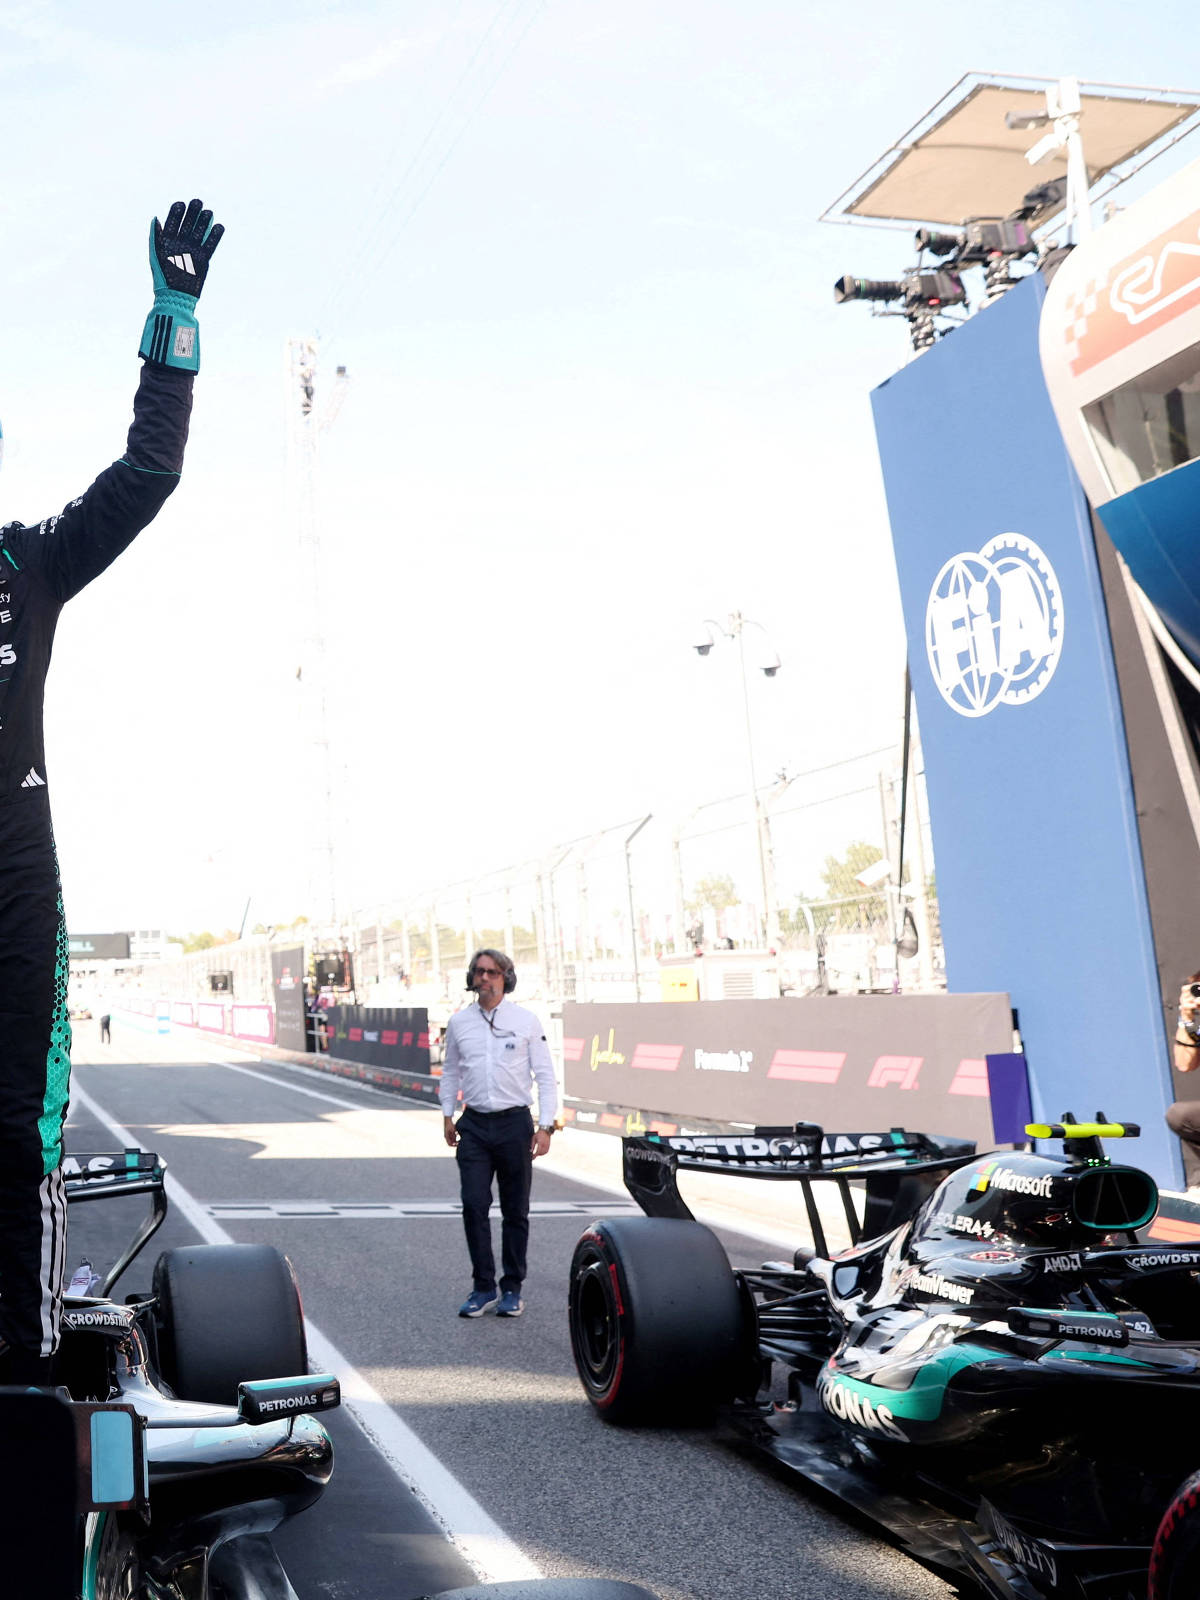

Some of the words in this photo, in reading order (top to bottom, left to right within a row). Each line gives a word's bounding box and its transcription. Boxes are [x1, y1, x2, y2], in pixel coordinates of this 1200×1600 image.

[990, 1167, 1054, 1199] Microsoft
[1058, 1324, 1123, 1340] PETRONAS
[258, 1394, 318, 1414] PETRONAS
